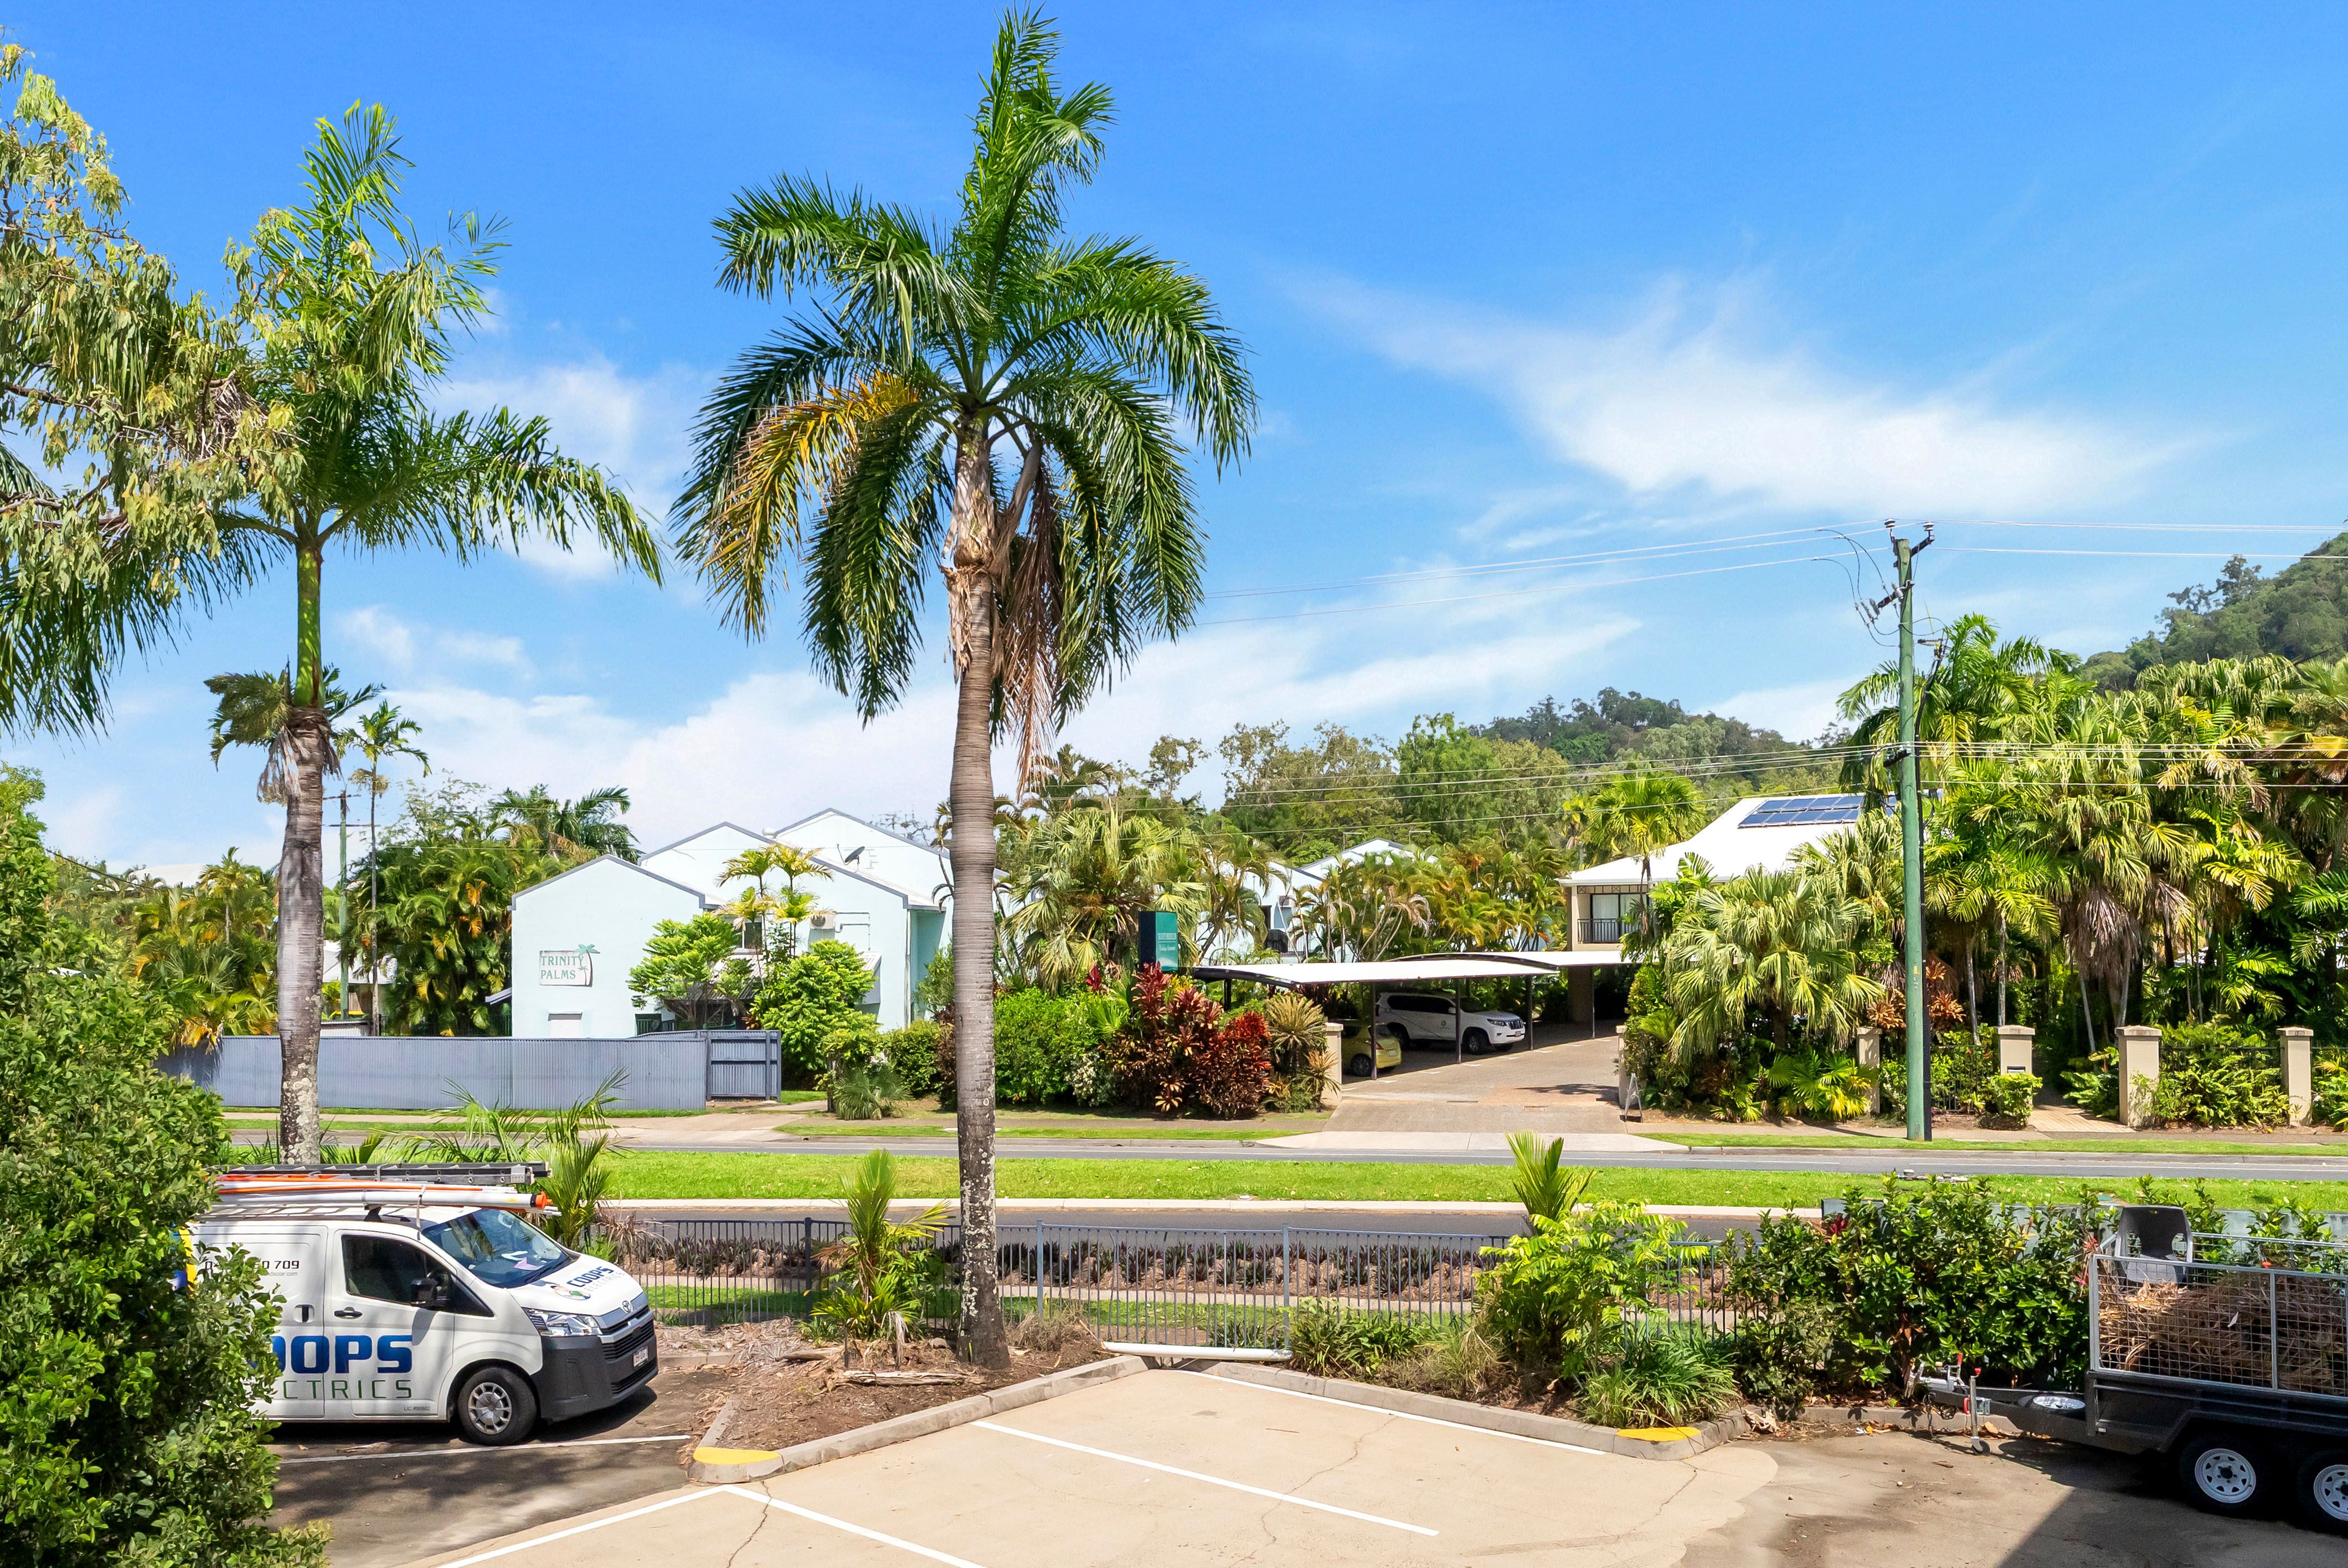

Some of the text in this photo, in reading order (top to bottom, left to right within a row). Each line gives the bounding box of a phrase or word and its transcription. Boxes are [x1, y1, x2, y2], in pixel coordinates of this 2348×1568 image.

[540, 956, 584, 966] TRINITY
[540, 969, 576, 979] PALMS
[274, 1260, 300, 1269] 709
[567, 1266, 614, 1287] COOPS
[584, 1272, 625, 1292] ELECTRICS
[283, 1380, 412, 1399] CTRICS
